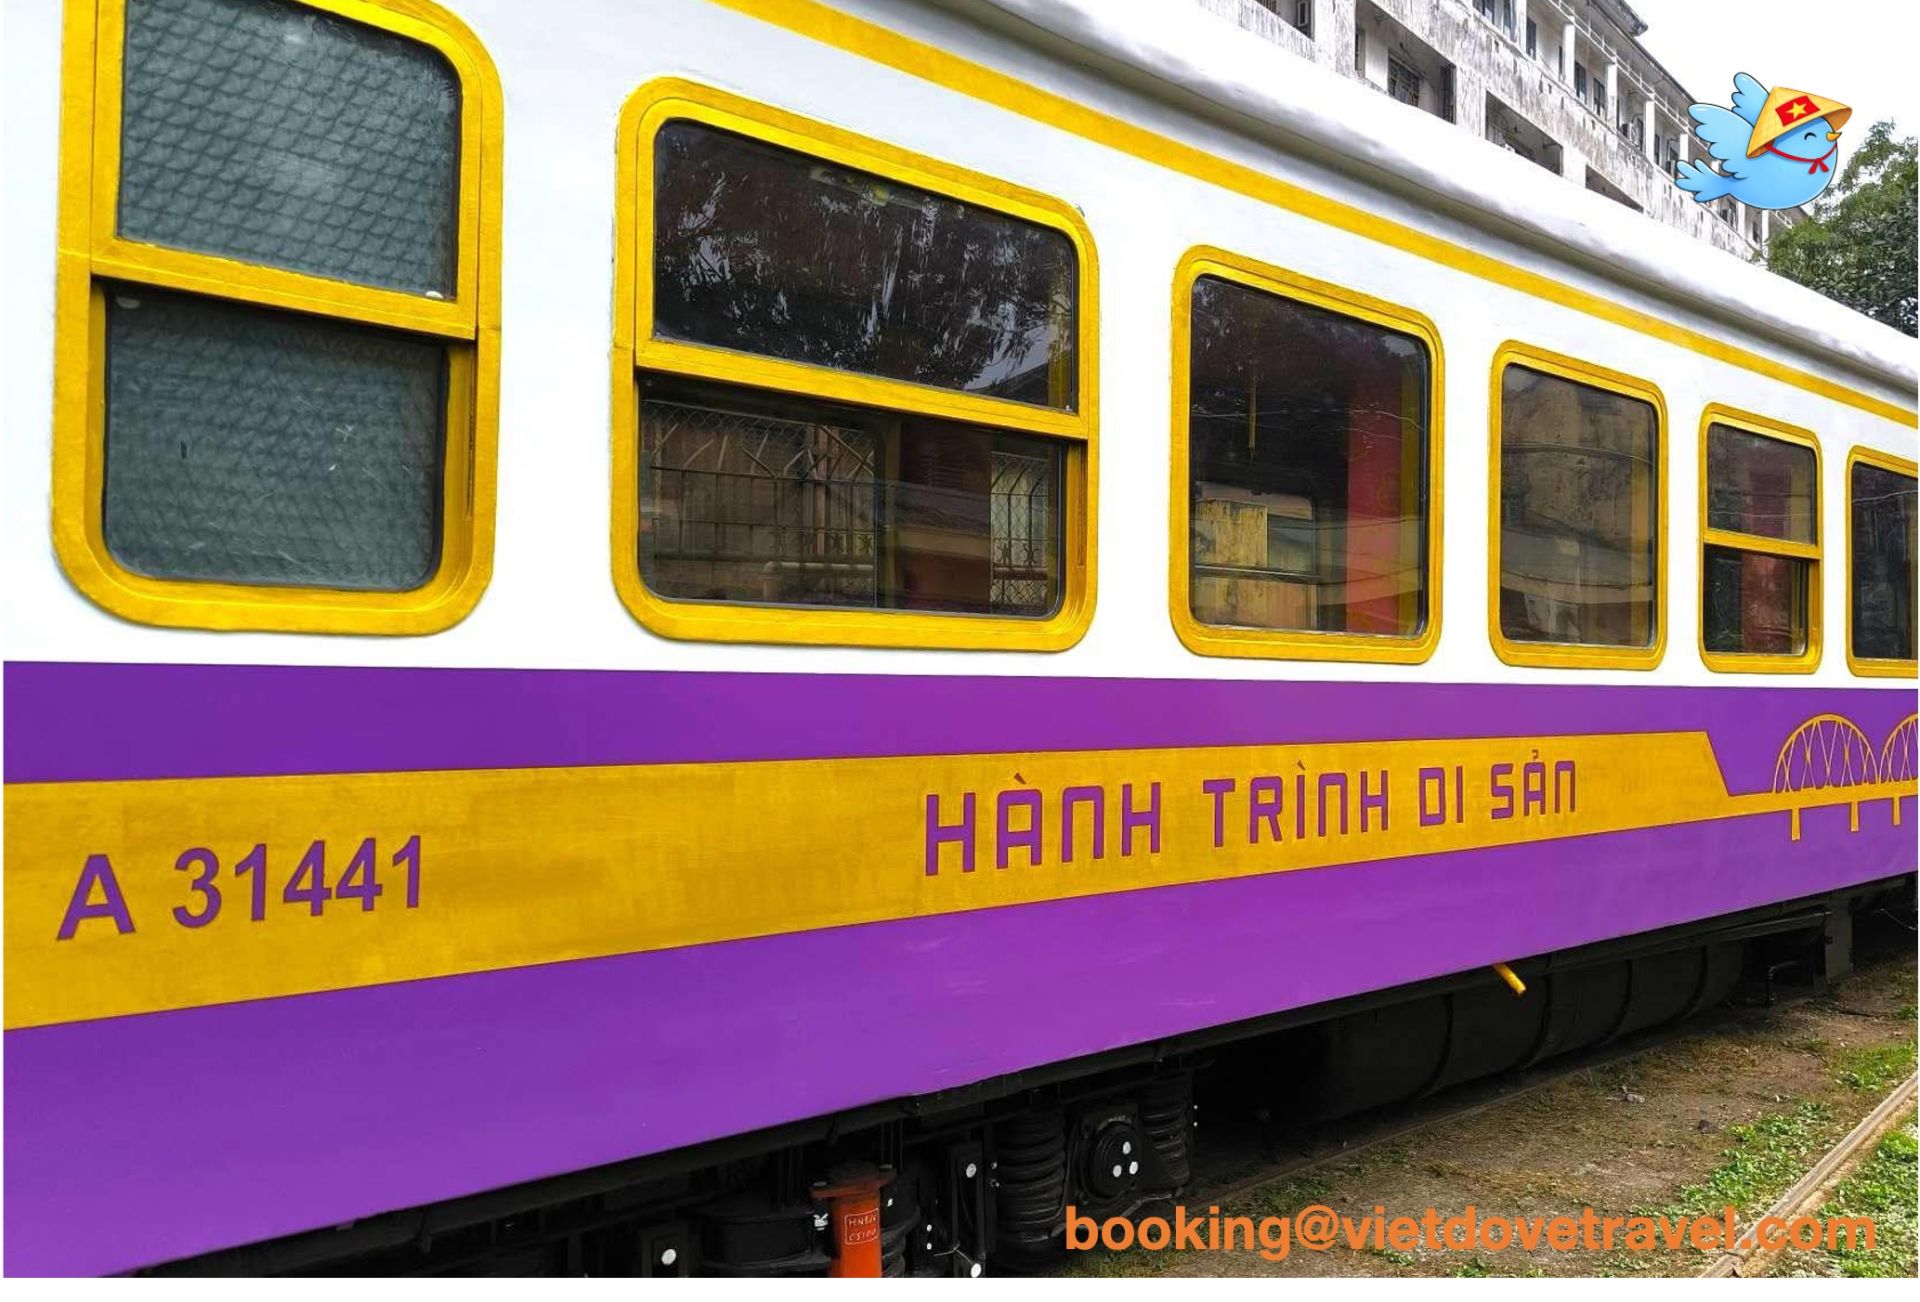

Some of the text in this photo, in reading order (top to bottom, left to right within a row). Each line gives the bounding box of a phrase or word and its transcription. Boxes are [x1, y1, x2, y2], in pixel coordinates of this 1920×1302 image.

[925, 749, 1576, 876] HÀNH TRÌNH DI SẢN
[56, 835, 421, 941] A 31441
